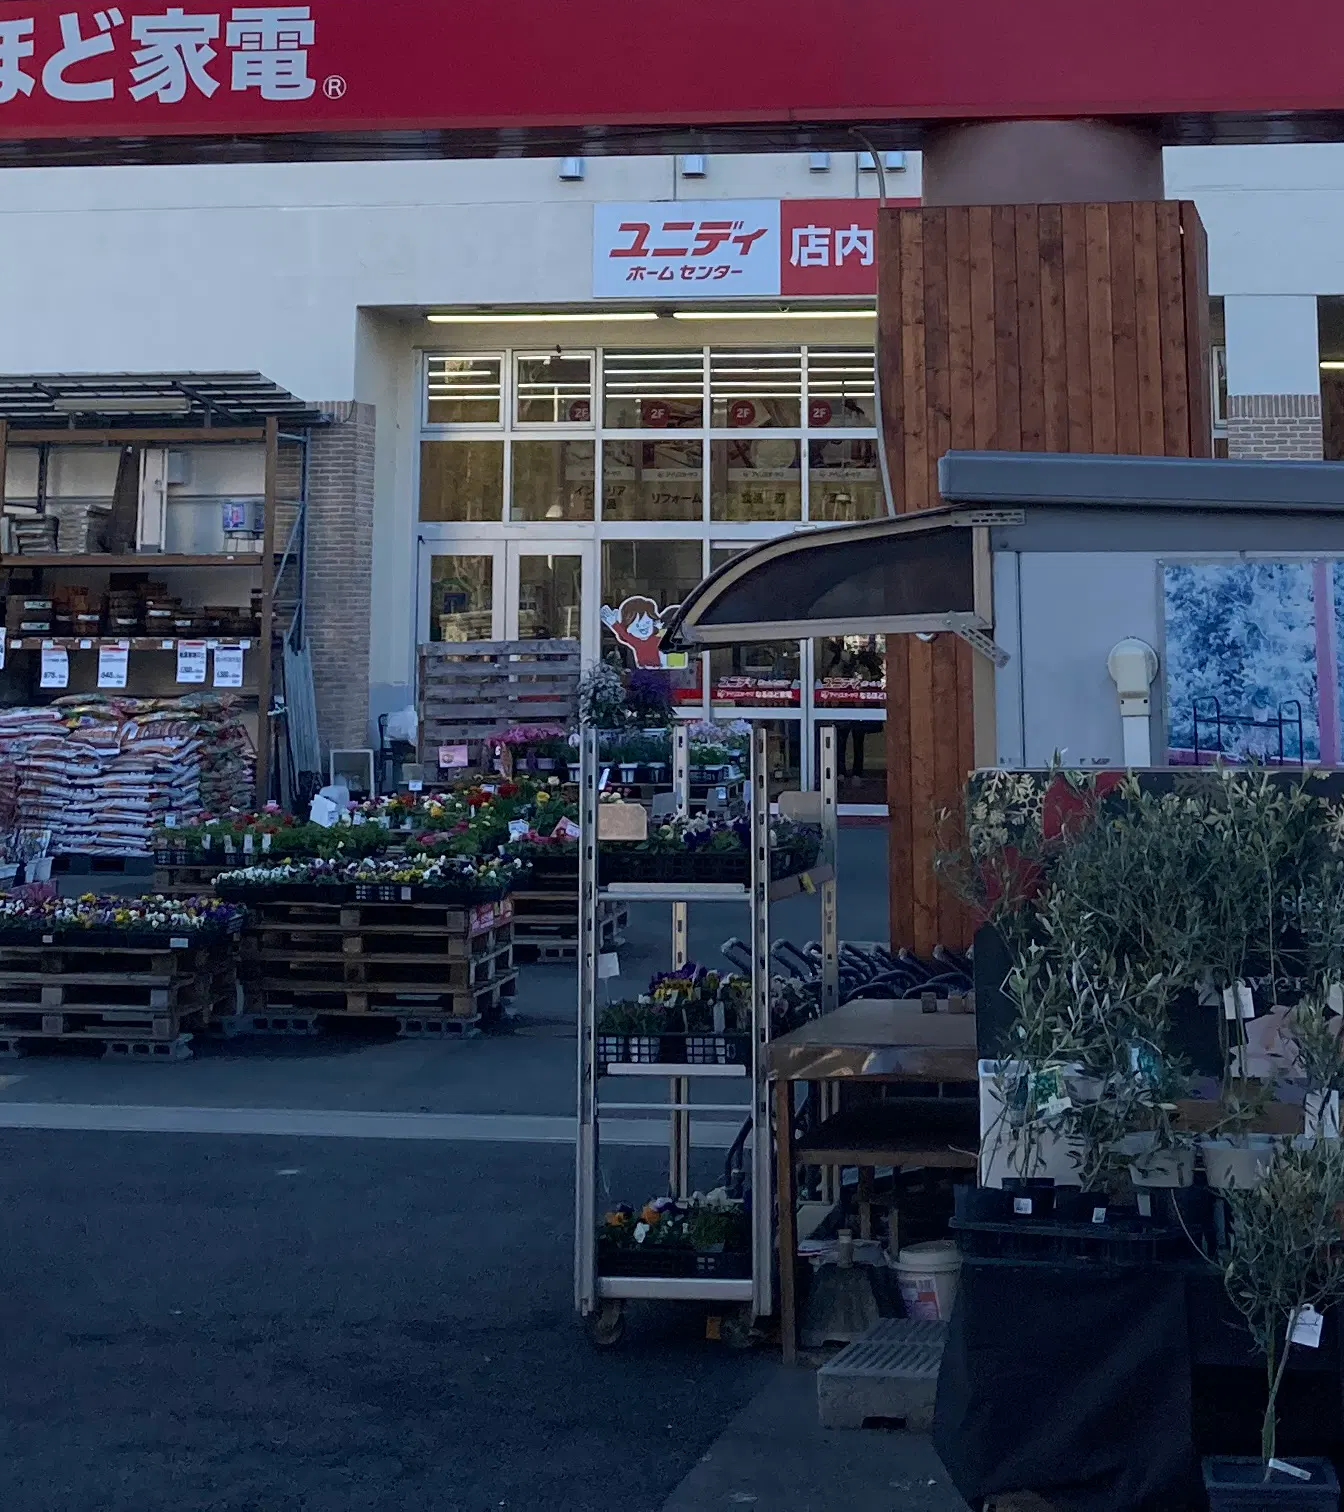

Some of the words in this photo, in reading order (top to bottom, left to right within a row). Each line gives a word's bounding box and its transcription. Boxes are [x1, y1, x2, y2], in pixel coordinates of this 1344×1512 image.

[608, 219, 769, 259] ユニディ
[789, 223, 875, 268] 店内
[650, 408, 666, 420] 2F
[736, 407, 752, 419] 2F
[812, 407, 828, 419] 2F
